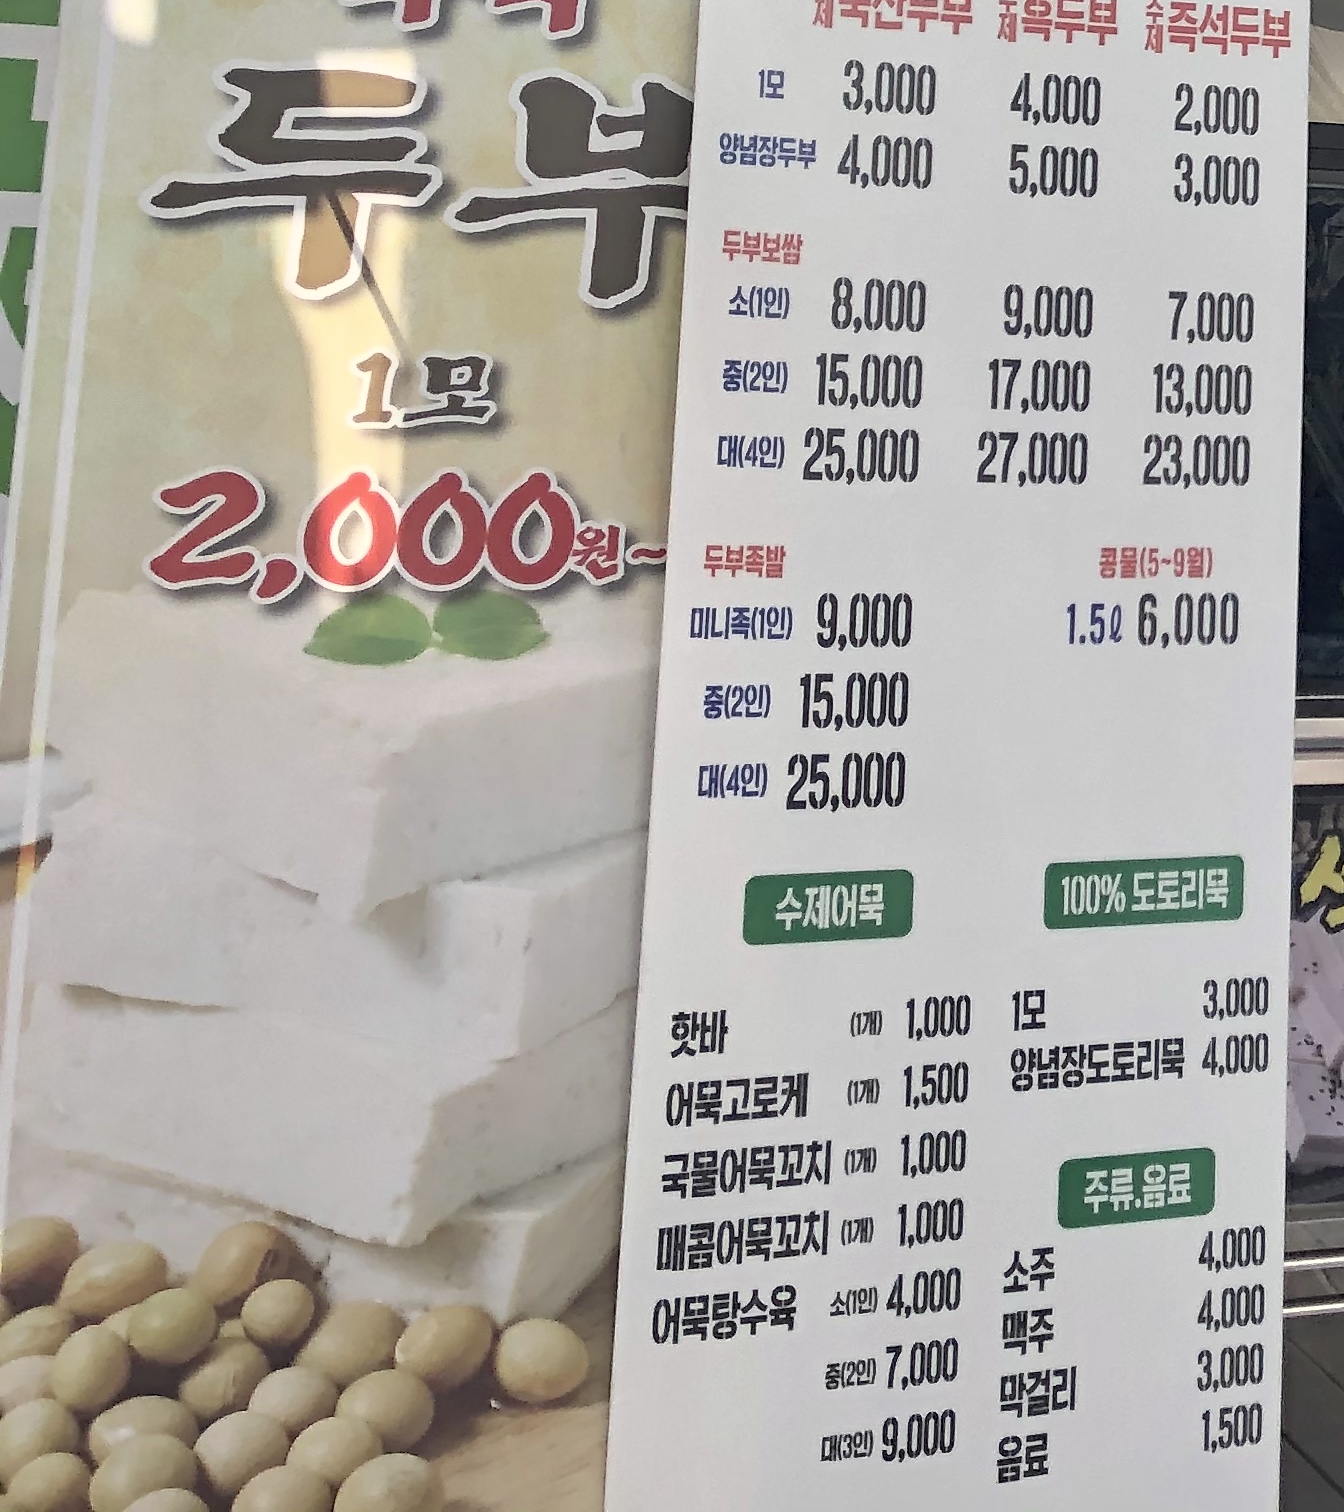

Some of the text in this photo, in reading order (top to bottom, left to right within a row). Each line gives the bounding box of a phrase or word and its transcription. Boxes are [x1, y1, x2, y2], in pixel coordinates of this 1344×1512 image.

[1169, 1, 1291, 58] 즉석두부
[758, 60, 1259, 136] 1모 3,000 4,000 2,000
[152, 67, 692, 302] 두부
[720, 132, 1259, 206] 양념장두부 4,000 5,000 3,000
[722, 231, 803, 265] 두부보쌈
[729, 278, 1254, 344] 소(1인) 8,000 9,000 7,000
[354, 354, 497, 426] 1모
[722, 354, 1252, 416] 중(2인) 15,000 17,000 13,000
[718, 428, 1250, 489] 대(4인) 25,000 27,000 23,000
[148, 471, 667, 600] 2,000원~
[703, 545, 786, 579] 두부족발
[1099, 547, 1214, 579] 콩물(5~9월)
[690, 593, 913, 650] 미니족(1인) 9,000
[1138, 592, 1239, 648] 6,000
[703, 672, 909, 730] 중(2인) 15,000
[698, 752, 905, 811] 대(4인) 25,000
[775, 883, 885, 930] 수제어묵
[1061, 867, 1229, 915] 100% 도토리묵
[671, 995, 971, 1057] 핫바 (1개) 1,000
[1013, 977, 1269, 1031] 1모 3,000
[1011, 1034, 1269, 1092] 양념장도토리묵 4,000
[665, 1063, 969, 1127] 어묵고로케 (1개) 1,500
[661, 1130, 966, 1200] 국물어묵꼬치 (1개) 1,000
[1084, 1164, 1192, 1211] 주류.음료
[657, 1199, 964, 1271] 매콤어묵꼬치 (1개) 1,000
[1003, 1226, 1266, 1294] 소주 4,000
[652, 1268, 961, 1344] 어묵탕수육 소(1인) 4,000
[1003, 1284, 1265, 1355] 맥주 4,000
[825, 1338, 959, 1390] 중(2인) 7,000
[1000, 1343, 1264, 1419] 막걸리 3,000
[821, 1409, 956, 1463] 대(3인) 9,000
[997, 1403, 1263, 1483] 음료 1,500
